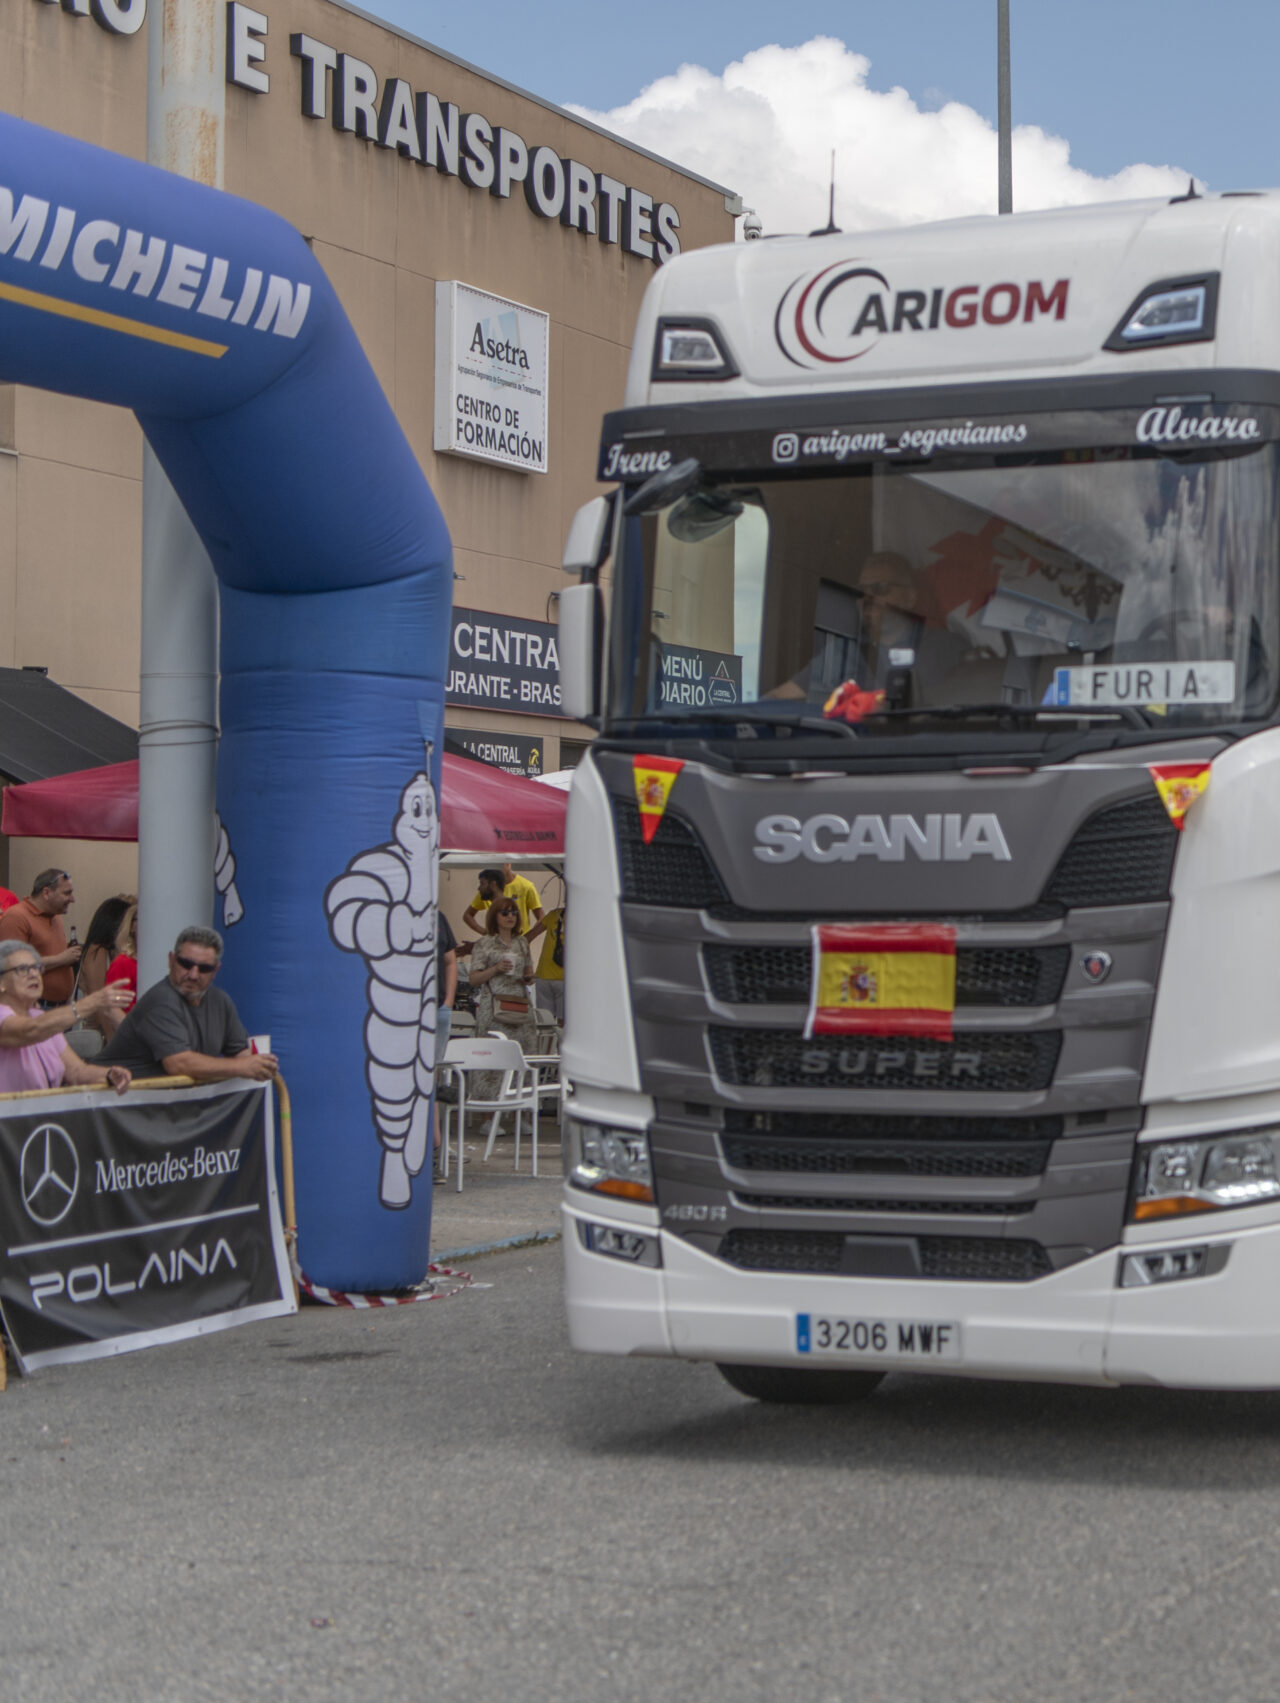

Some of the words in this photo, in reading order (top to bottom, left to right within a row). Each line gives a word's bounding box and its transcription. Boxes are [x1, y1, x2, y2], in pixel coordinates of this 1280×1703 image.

[291, 33, 682, 266] TRANSPORTES
[0, 186, 312, 339] MICHELIN
[850, 278, 1071, 337] ARIGOM
[470, 322, 530, 370] Asetra
[456, 394, 501, 423] CENTRO
[505, 408, 519, 429] DE
[1136, 405, 1260, 442] Alvaro
[456, 417, 542, 462] FORMACIÓN
[604, 443, 671, 476] Irene
[802, 420, 1027, 460] arigom_segovianos
[454, 622, 560, 671] CENTRA
[661, 654, 703, 680] MENÚ
[1092, 669, 1199, 699] FURIA
[445, 670, 511, 699] URANTE
[520, 680, 562, 705] BRAS
[478, 743, 521, 764] CENTRAL
[753, 813, 1012, 863] SCANIA
[802, 1050, 981, 1077] SUPER
[95, 1146, 240, 1193] Mercedes-Benz
[29, 1238, 237, 1309] POLAINA
[817, 1319, 888, 1351] 3206
[898, 1323, 952, 1353] MWF
